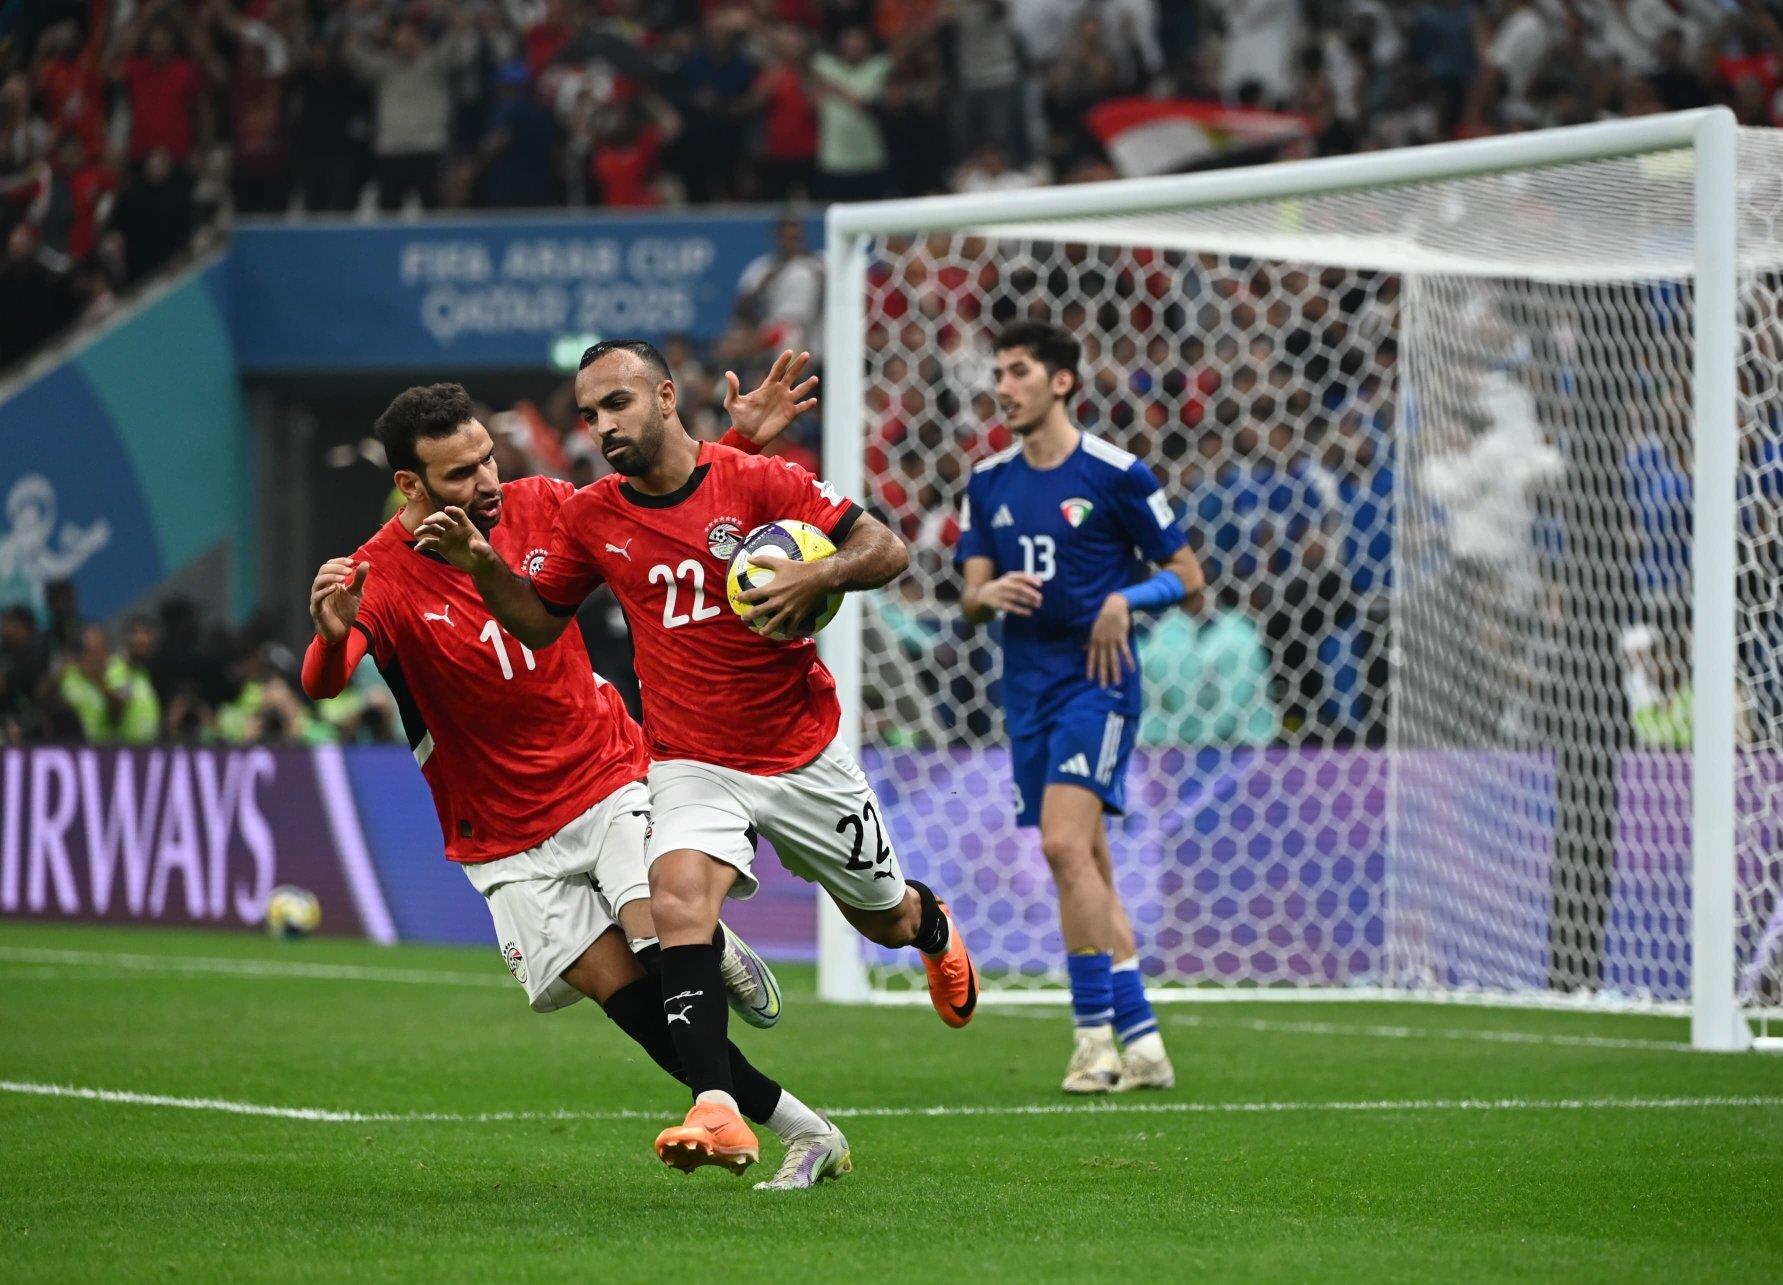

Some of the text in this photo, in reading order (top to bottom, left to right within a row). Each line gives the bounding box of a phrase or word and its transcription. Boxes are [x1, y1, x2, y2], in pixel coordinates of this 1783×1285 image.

[401, 236, 715, 283] FIFA ARAB CUP
[420, 285, 567, 343] QATAR
[1018, 535, 1056, 582] 13
[648, 559, 721, 629] 22
[1, 746, 276, 924] IRWAYS
[836, 800, 890, 870] 22
